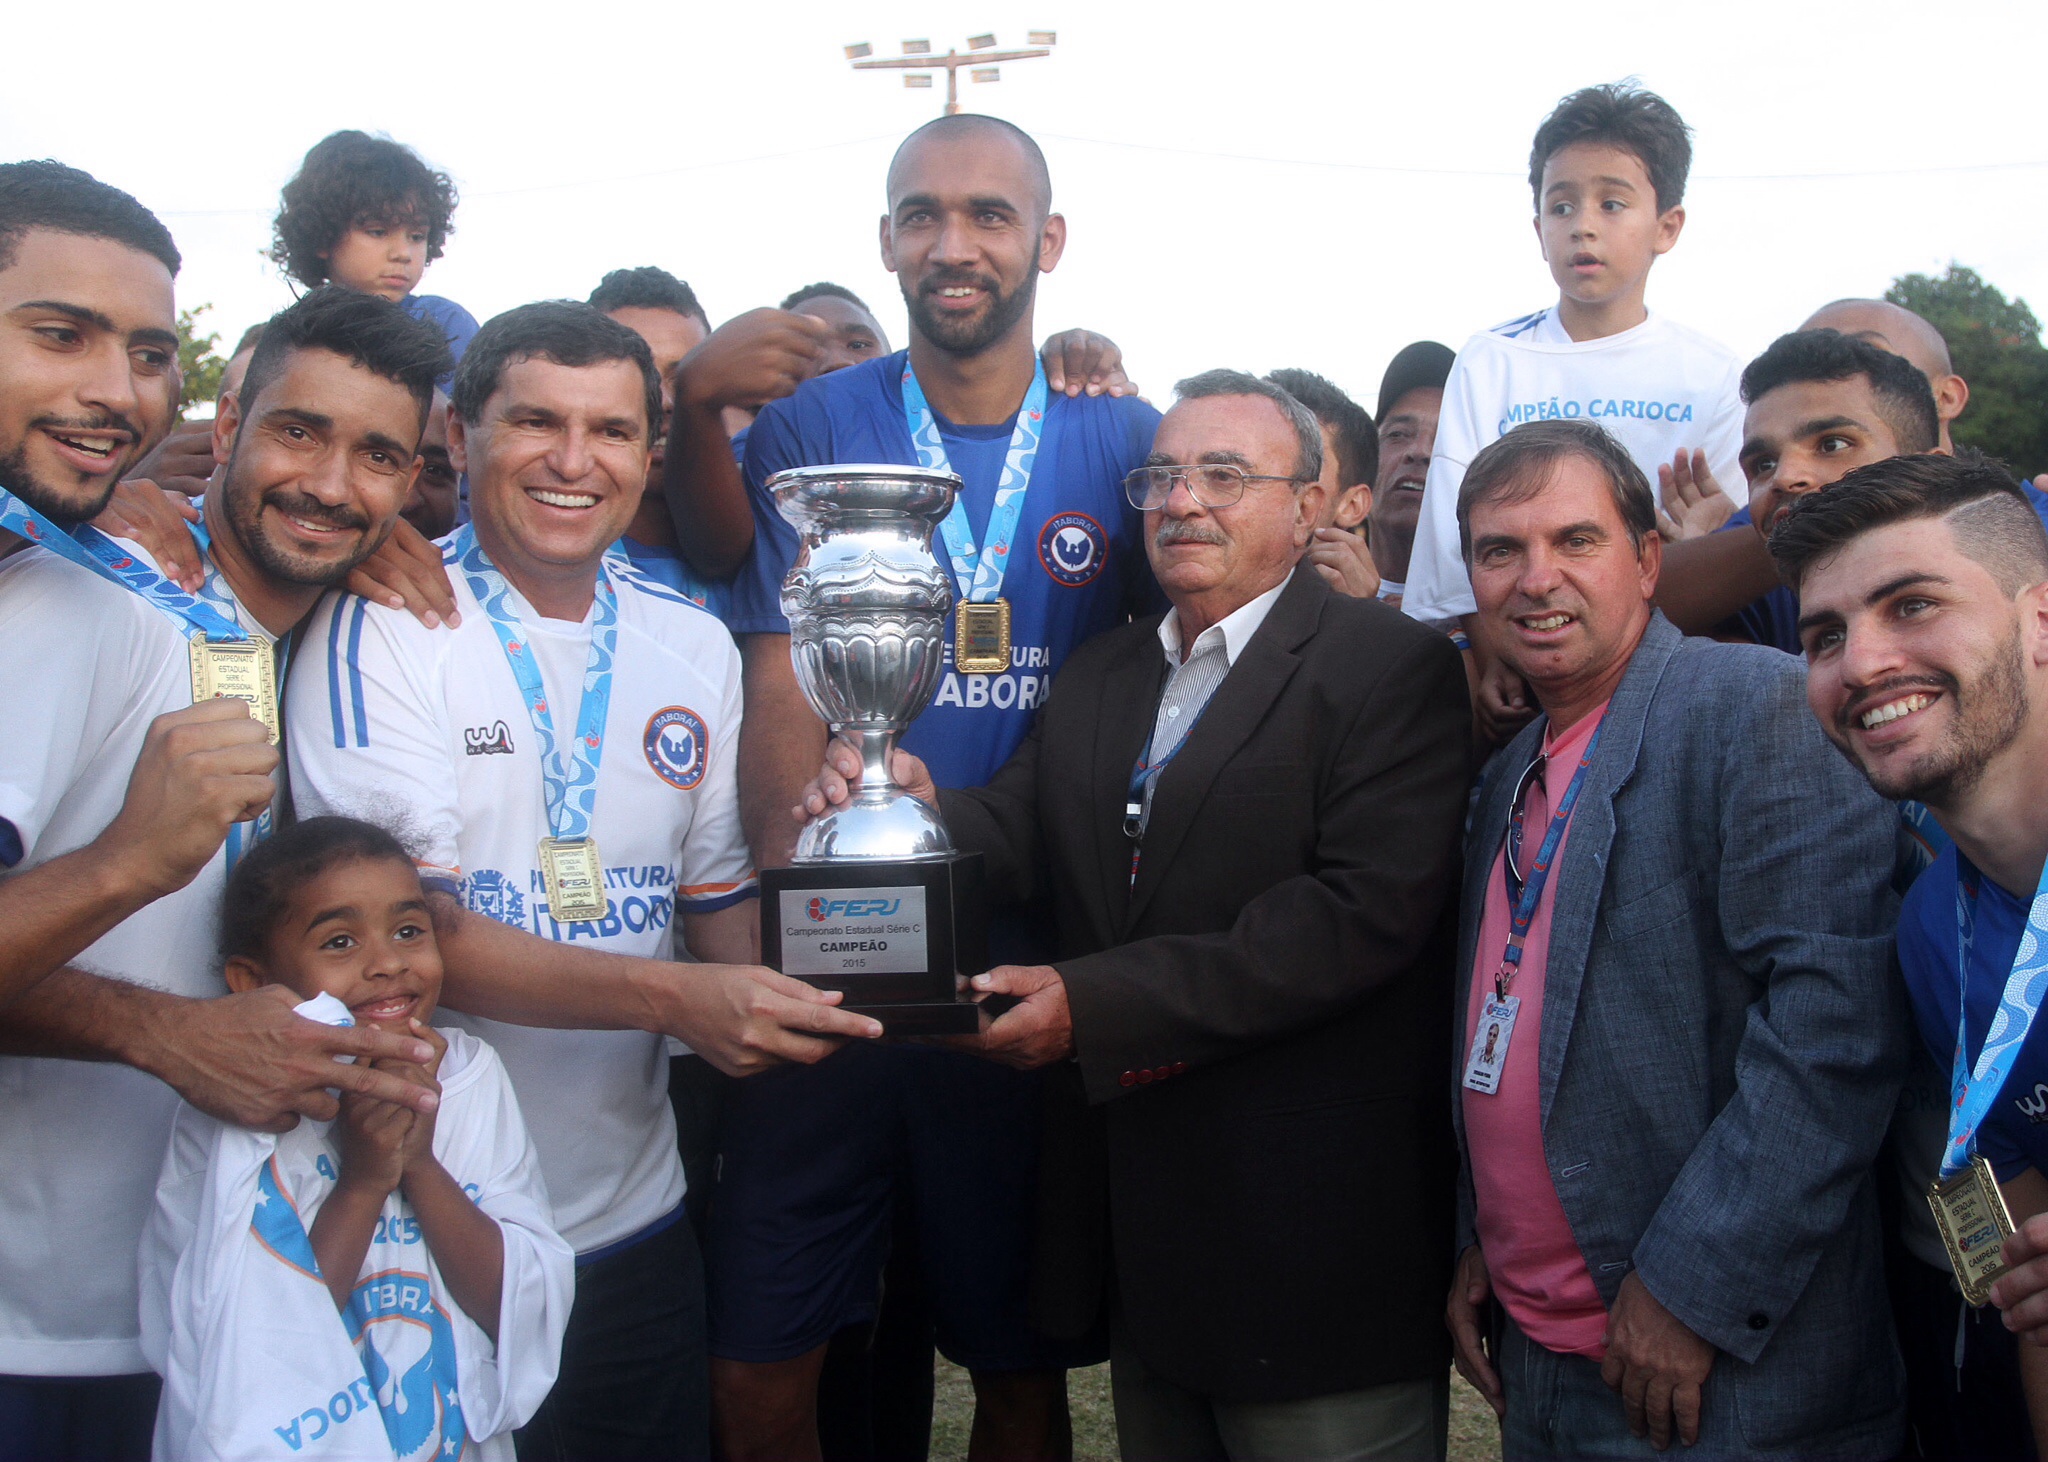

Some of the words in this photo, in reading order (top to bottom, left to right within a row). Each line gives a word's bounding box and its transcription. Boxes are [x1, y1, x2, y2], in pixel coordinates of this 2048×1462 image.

[1588, 399, 1693, 423] CARIOCA
[212, 654, 254, 663] CAMPEONATO
[219, 665, 250, 673] ESTADUAL
[826, 899, 901, 918] FERJ
[786, 927, 843, 938] Campeonato
[846, 924, 884, 935] Estadual
[887, 924, 910, 934] Série
[913, 924, 920, 933] C
[820, 940, 888, 952] CAMPEÃO
[843, 959, 866, 968] 2015
[1943, 1182, 1976, 1208] CAMPEONATO
[1952, 1198, 1977, 1216] ESTADUAL
[1966, 1223, 1995, 1248] FERJ
[1968, 1244, 2000, 1268] CAMPEÃO
[1981, 1261, 1997, 1275] 2015
